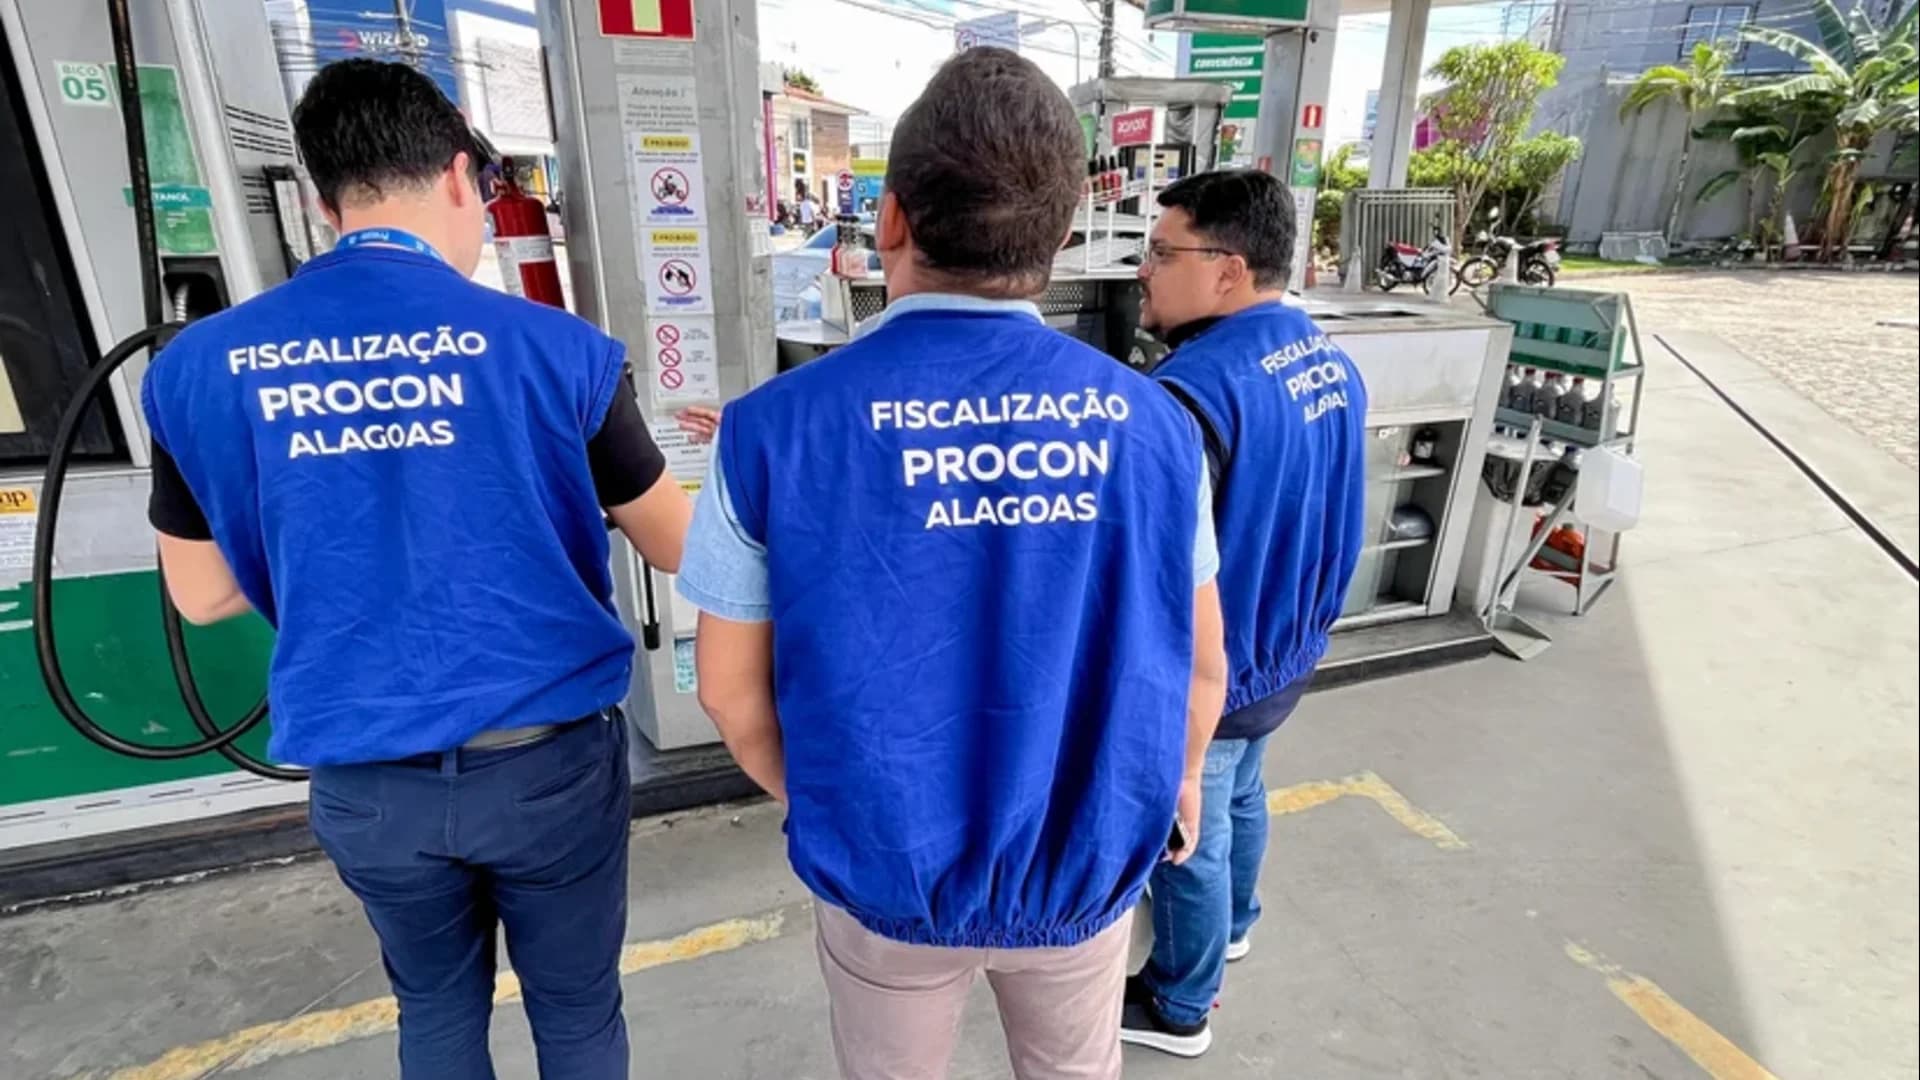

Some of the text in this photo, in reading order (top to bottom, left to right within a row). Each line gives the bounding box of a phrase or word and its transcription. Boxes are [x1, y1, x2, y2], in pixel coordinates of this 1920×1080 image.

[358, 31, 429, 47] WIZD
[62, 76, 106, 101] 05
[63, 64, 99, 77] BICO
[228, 326, 487, 374] FISCALIZAÇÃO
[258, 373, 463, 421] PROCON
[871, 387, 1129, 431] FISCALIZAÇÃO
[288, 420, 455, 459] ALAGOAS
[902, 439, 1109, 487] PROCON
[925, 492, 1098, 529] ALAGOAS
